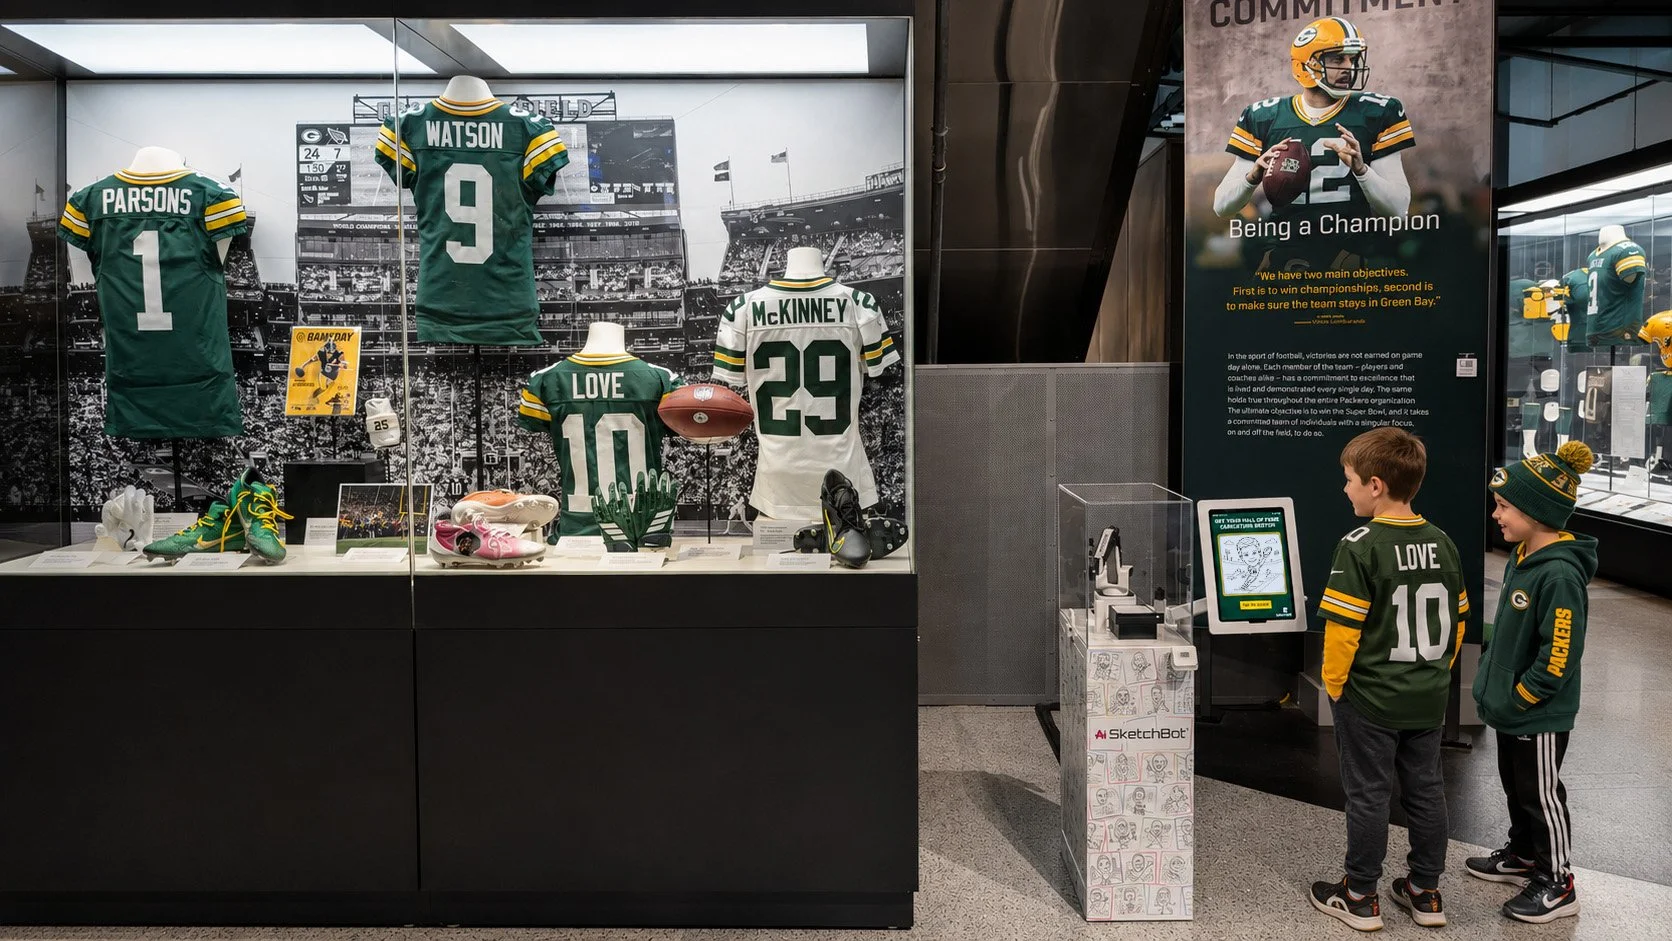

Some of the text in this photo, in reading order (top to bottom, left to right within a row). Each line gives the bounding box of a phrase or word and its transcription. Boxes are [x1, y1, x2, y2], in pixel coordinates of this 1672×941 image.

[1210, 0, 1459, 28] COMMIT
[425, 120, 504, 149] WATSON
[304, 148, 341, 159] 24 7
[102, 187, 193, 215] PARSONS
[444, 162, 493, 264] 9
[1229, 213, 1440, 241] Being a Champion
[133, 230, 173, 331] 1
[1278, 271, 1301, 280] have
[1304, 272, 1323, 280] two
[1325, 270, 1350, 279] main
[1352, 268, 1408, 280] objectives.
[1234, 282, 1433, 296] First is to win championships, second is
[752, 297, 848, 327] McKINNEY
[1227, 301, 1236, 310] to
[1238, 300, 1265, 310] make
[1268, 302, 1290, 310] sure
[1292, 300, 1308, 309] the
[1310, 300, 1336, 309] team
[1368, 298, 1378, 307] in
[1381, 298, 1412, 307] Green
[572, 372, 625, 400] LOVE
[753, 339, 851, 436] 29
[374, 420, 389, 431] 25
[561, 412, 646, 514] 10
[1394, 543, 1441, 571] LOVE
[1388, 582, 1451, 662] 10
[1546, 607, 1573, 678] PACKERS
[1095, 728, 1186, 740] Ai SketchBot
